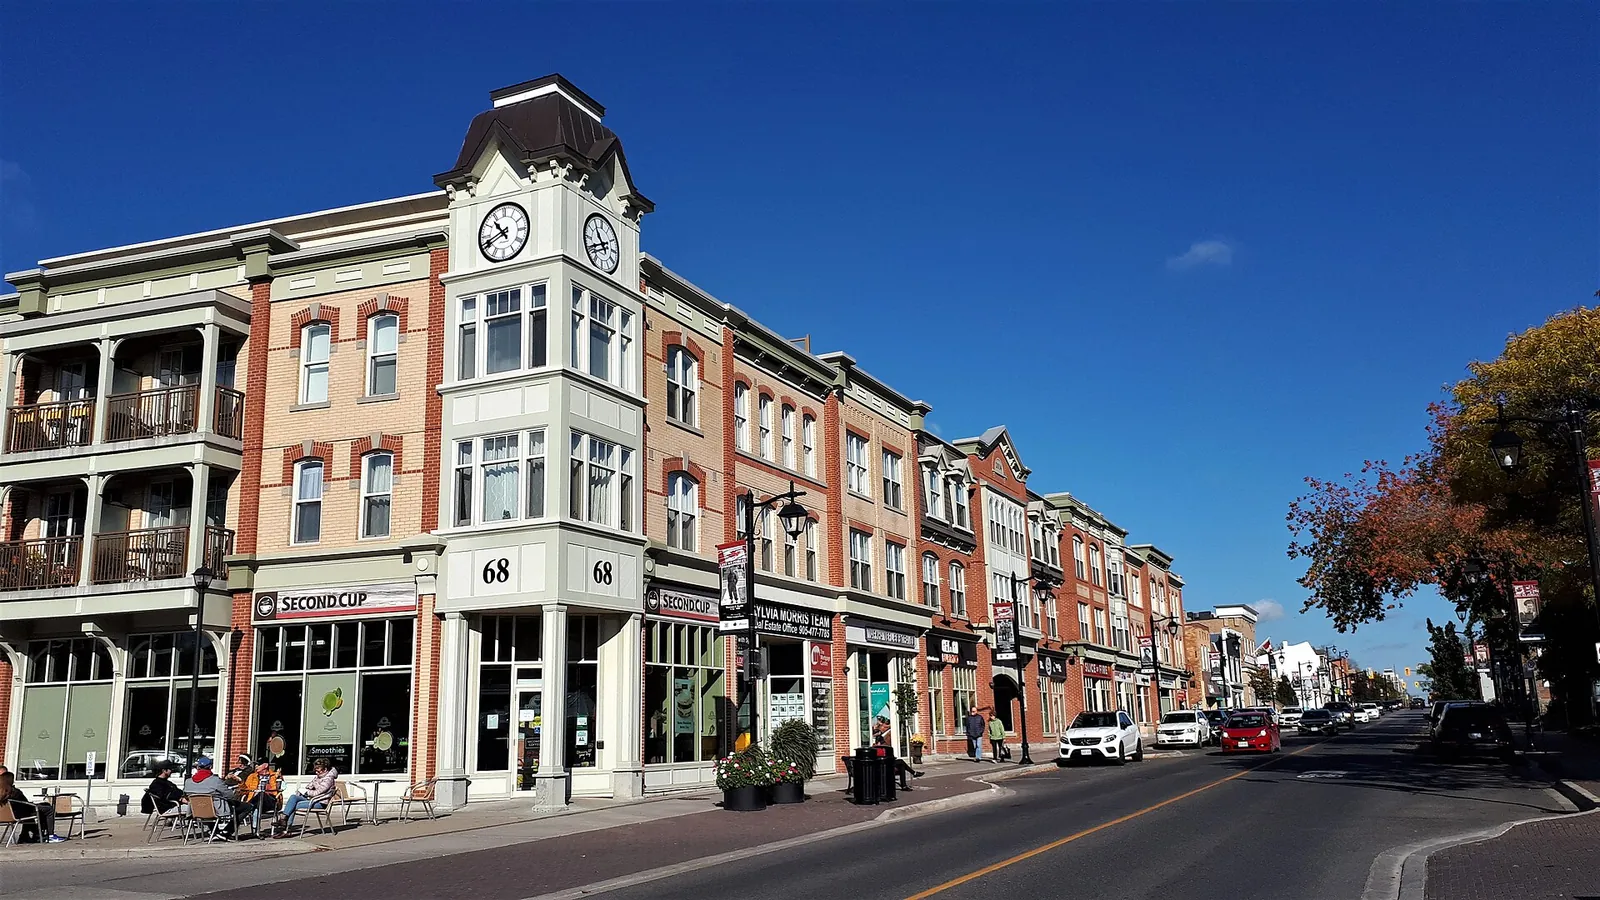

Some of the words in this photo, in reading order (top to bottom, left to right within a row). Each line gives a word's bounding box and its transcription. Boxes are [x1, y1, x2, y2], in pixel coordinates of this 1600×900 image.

[483, 558, 509, 584] 68
[593, 560, 613, 585] 68
[281, 594, 337, 611] SECOND
[338, 592, 368, 607] CUP
[663, 593, 695, 612] SECOND
[695, 598, 711, 613] CUP
[764, 620, 782, 632] Estate
[782, 622, 798, 634] Office
[779, 608, 810, 625] MORRIS
[811, 613, 830, 628] TEAM
[311, 746, 345, 754] Smoothies
